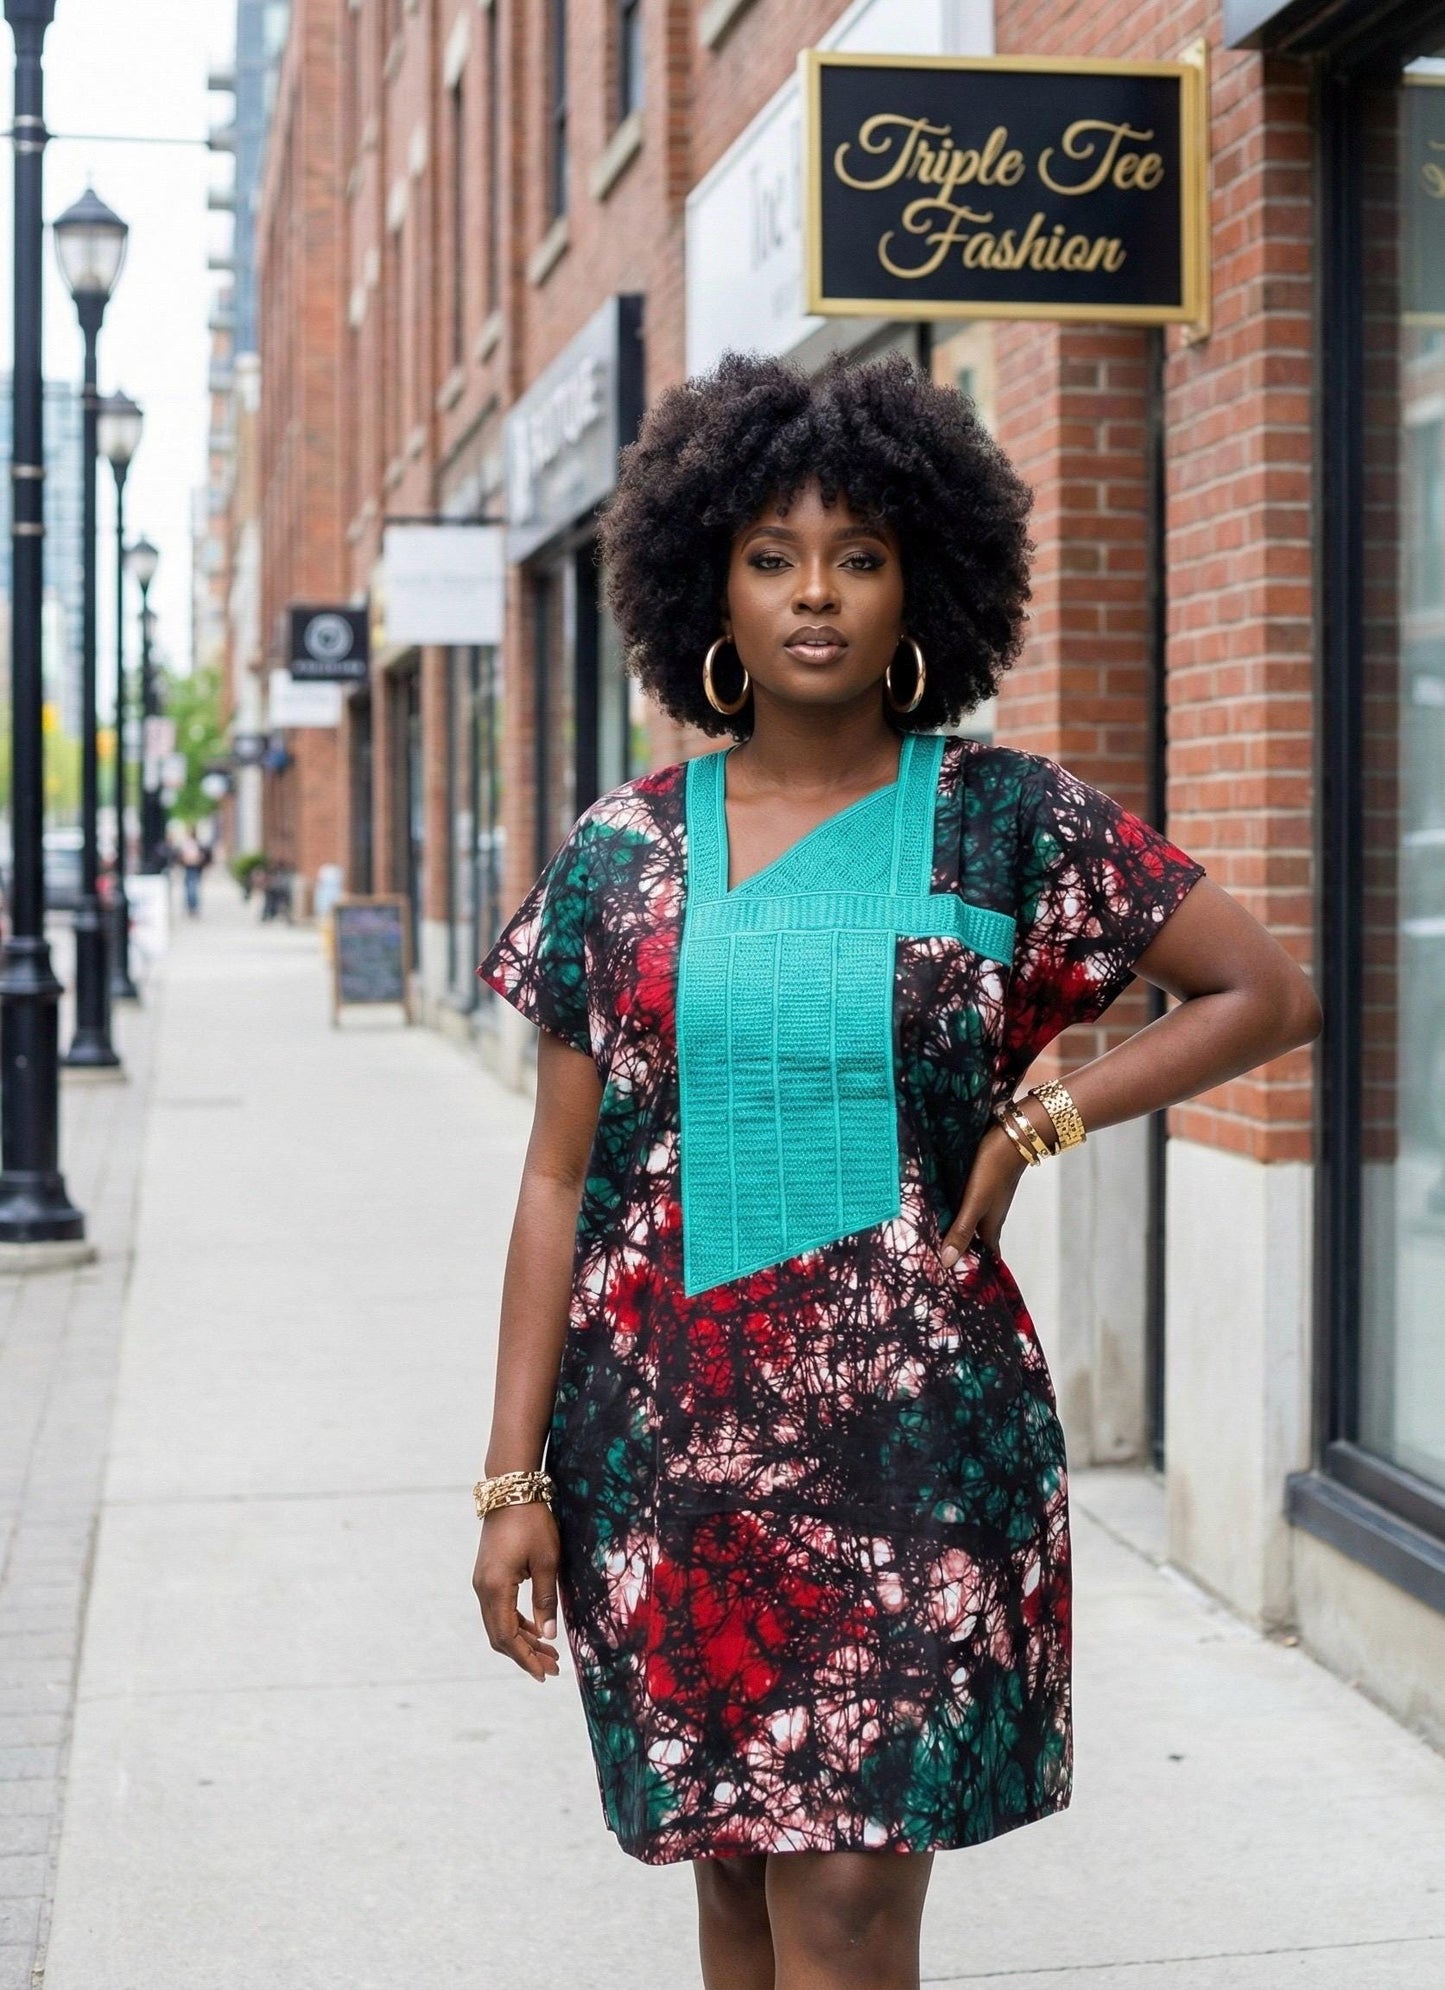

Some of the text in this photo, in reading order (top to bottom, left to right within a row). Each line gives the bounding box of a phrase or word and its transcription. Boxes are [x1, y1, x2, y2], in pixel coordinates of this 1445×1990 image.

[834, 113, 1026, 202] Triple
[1038, 119, 1165, 195] Tee
[878, 198, 1126, 278] Fashion
